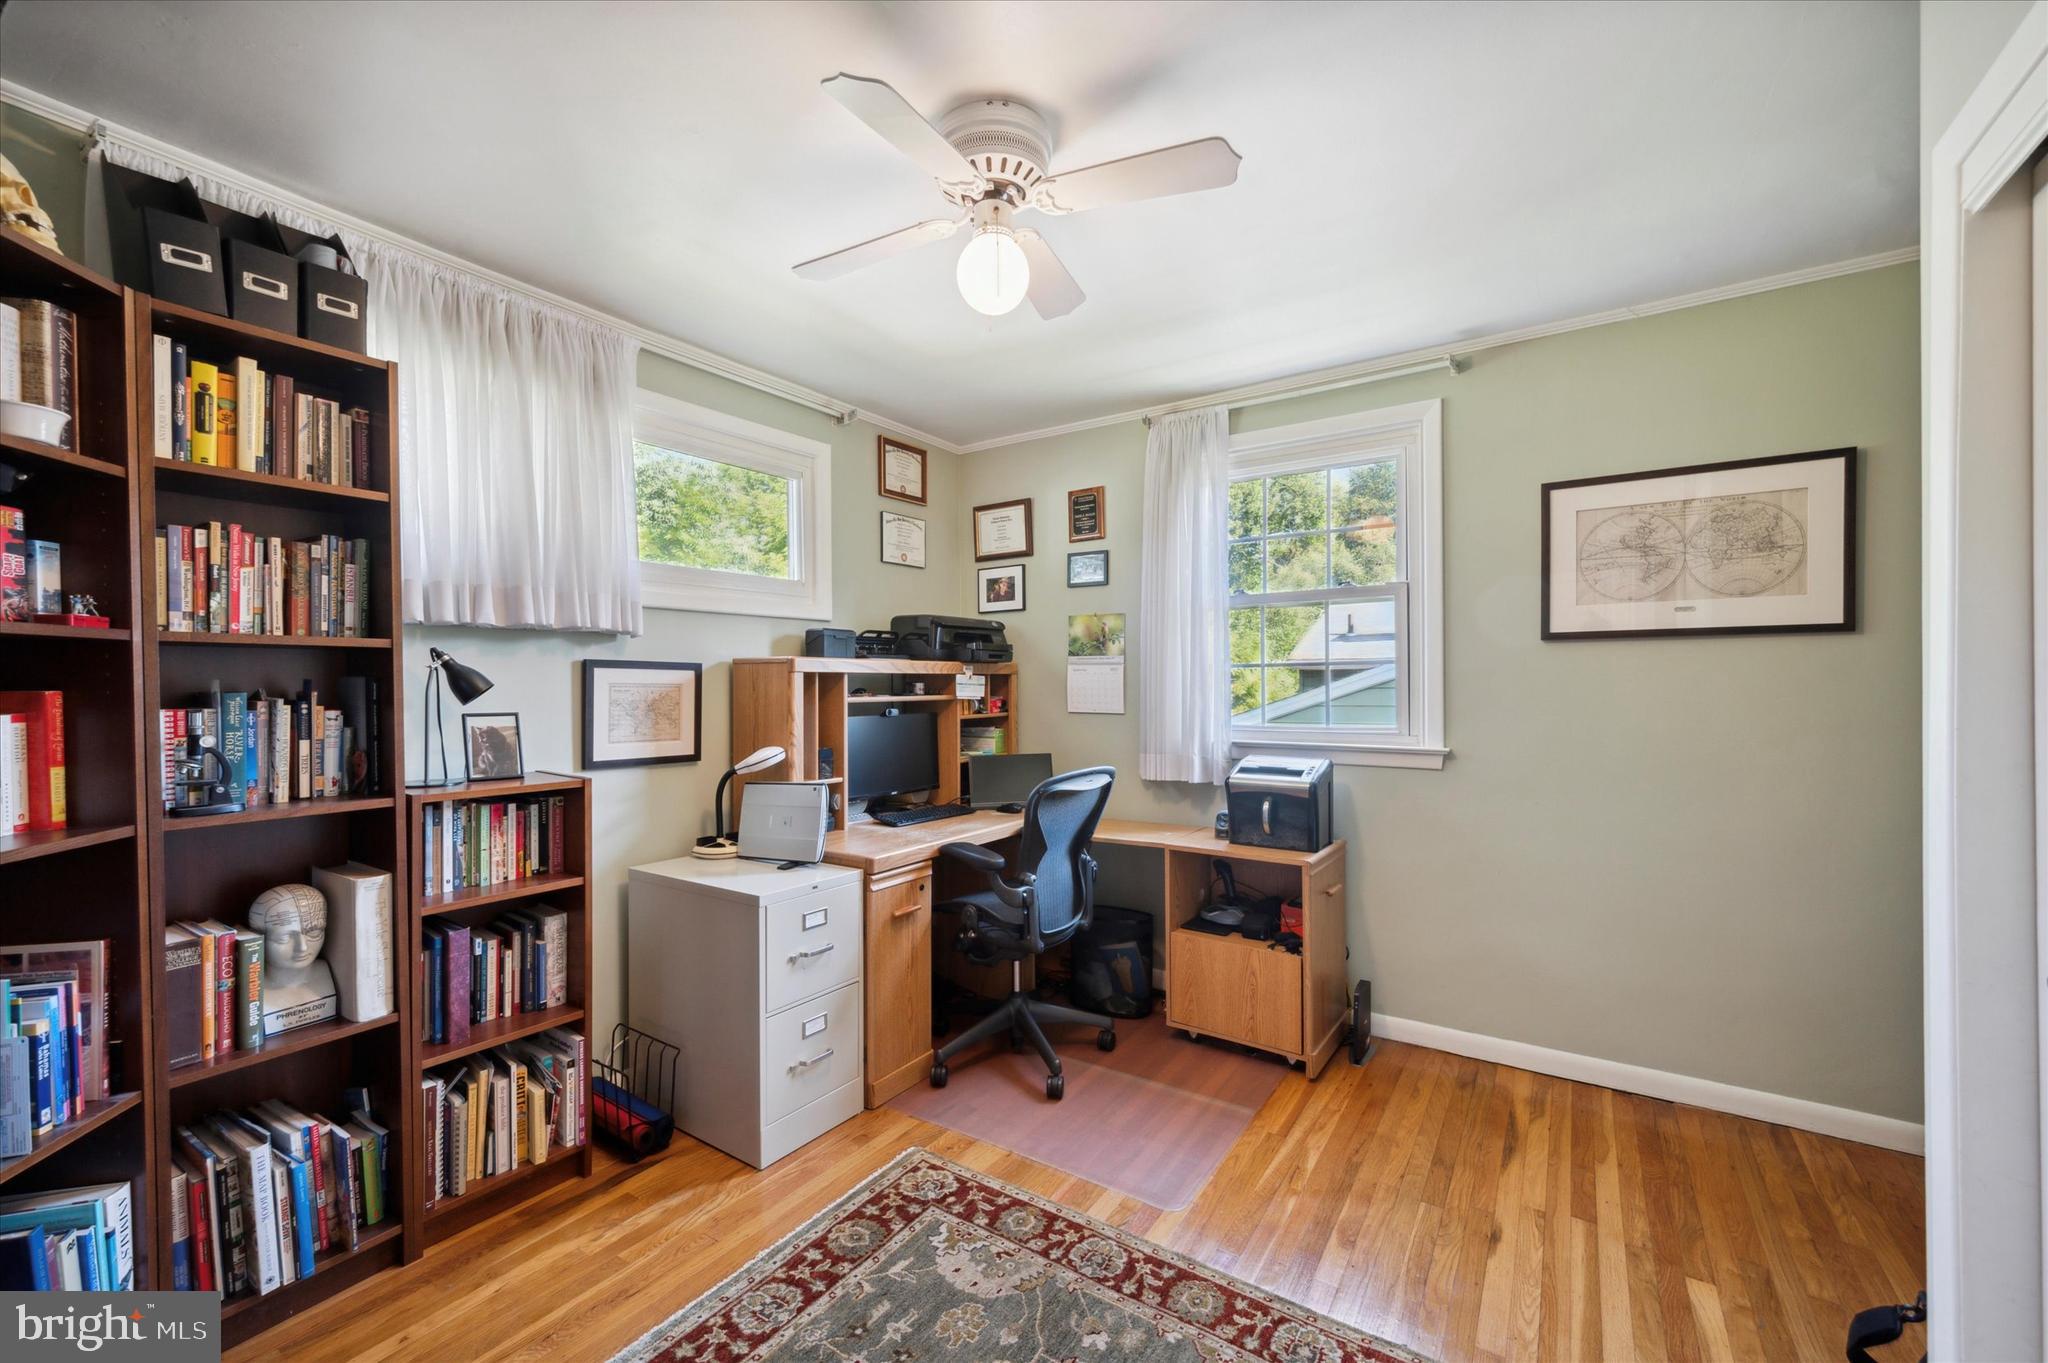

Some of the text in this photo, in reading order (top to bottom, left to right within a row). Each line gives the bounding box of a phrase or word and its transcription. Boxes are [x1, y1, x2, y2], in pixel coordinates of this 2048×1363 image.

[248, 728, 257, 748] Jordan
[300, 753, 309, 775] TREES
[314, 740, 322, 776] IRELAND
[222, 956, 234, 978] ECO
[248, 953, 261, 1027] The Warbler Guide
[223, 992, 232, 1034] BAUDOLINO
[276, 1002, 327, 1020] PHRENOLOGY
[42, 1043, 51, 1078] Bahamas
[257, 1154, 267, 1174] THE
[259, 1177, 268, 1195] MAP
[260, 1196, 272, 1223] BOOK
[118, 1196, 131, 1260] ANIMALS
